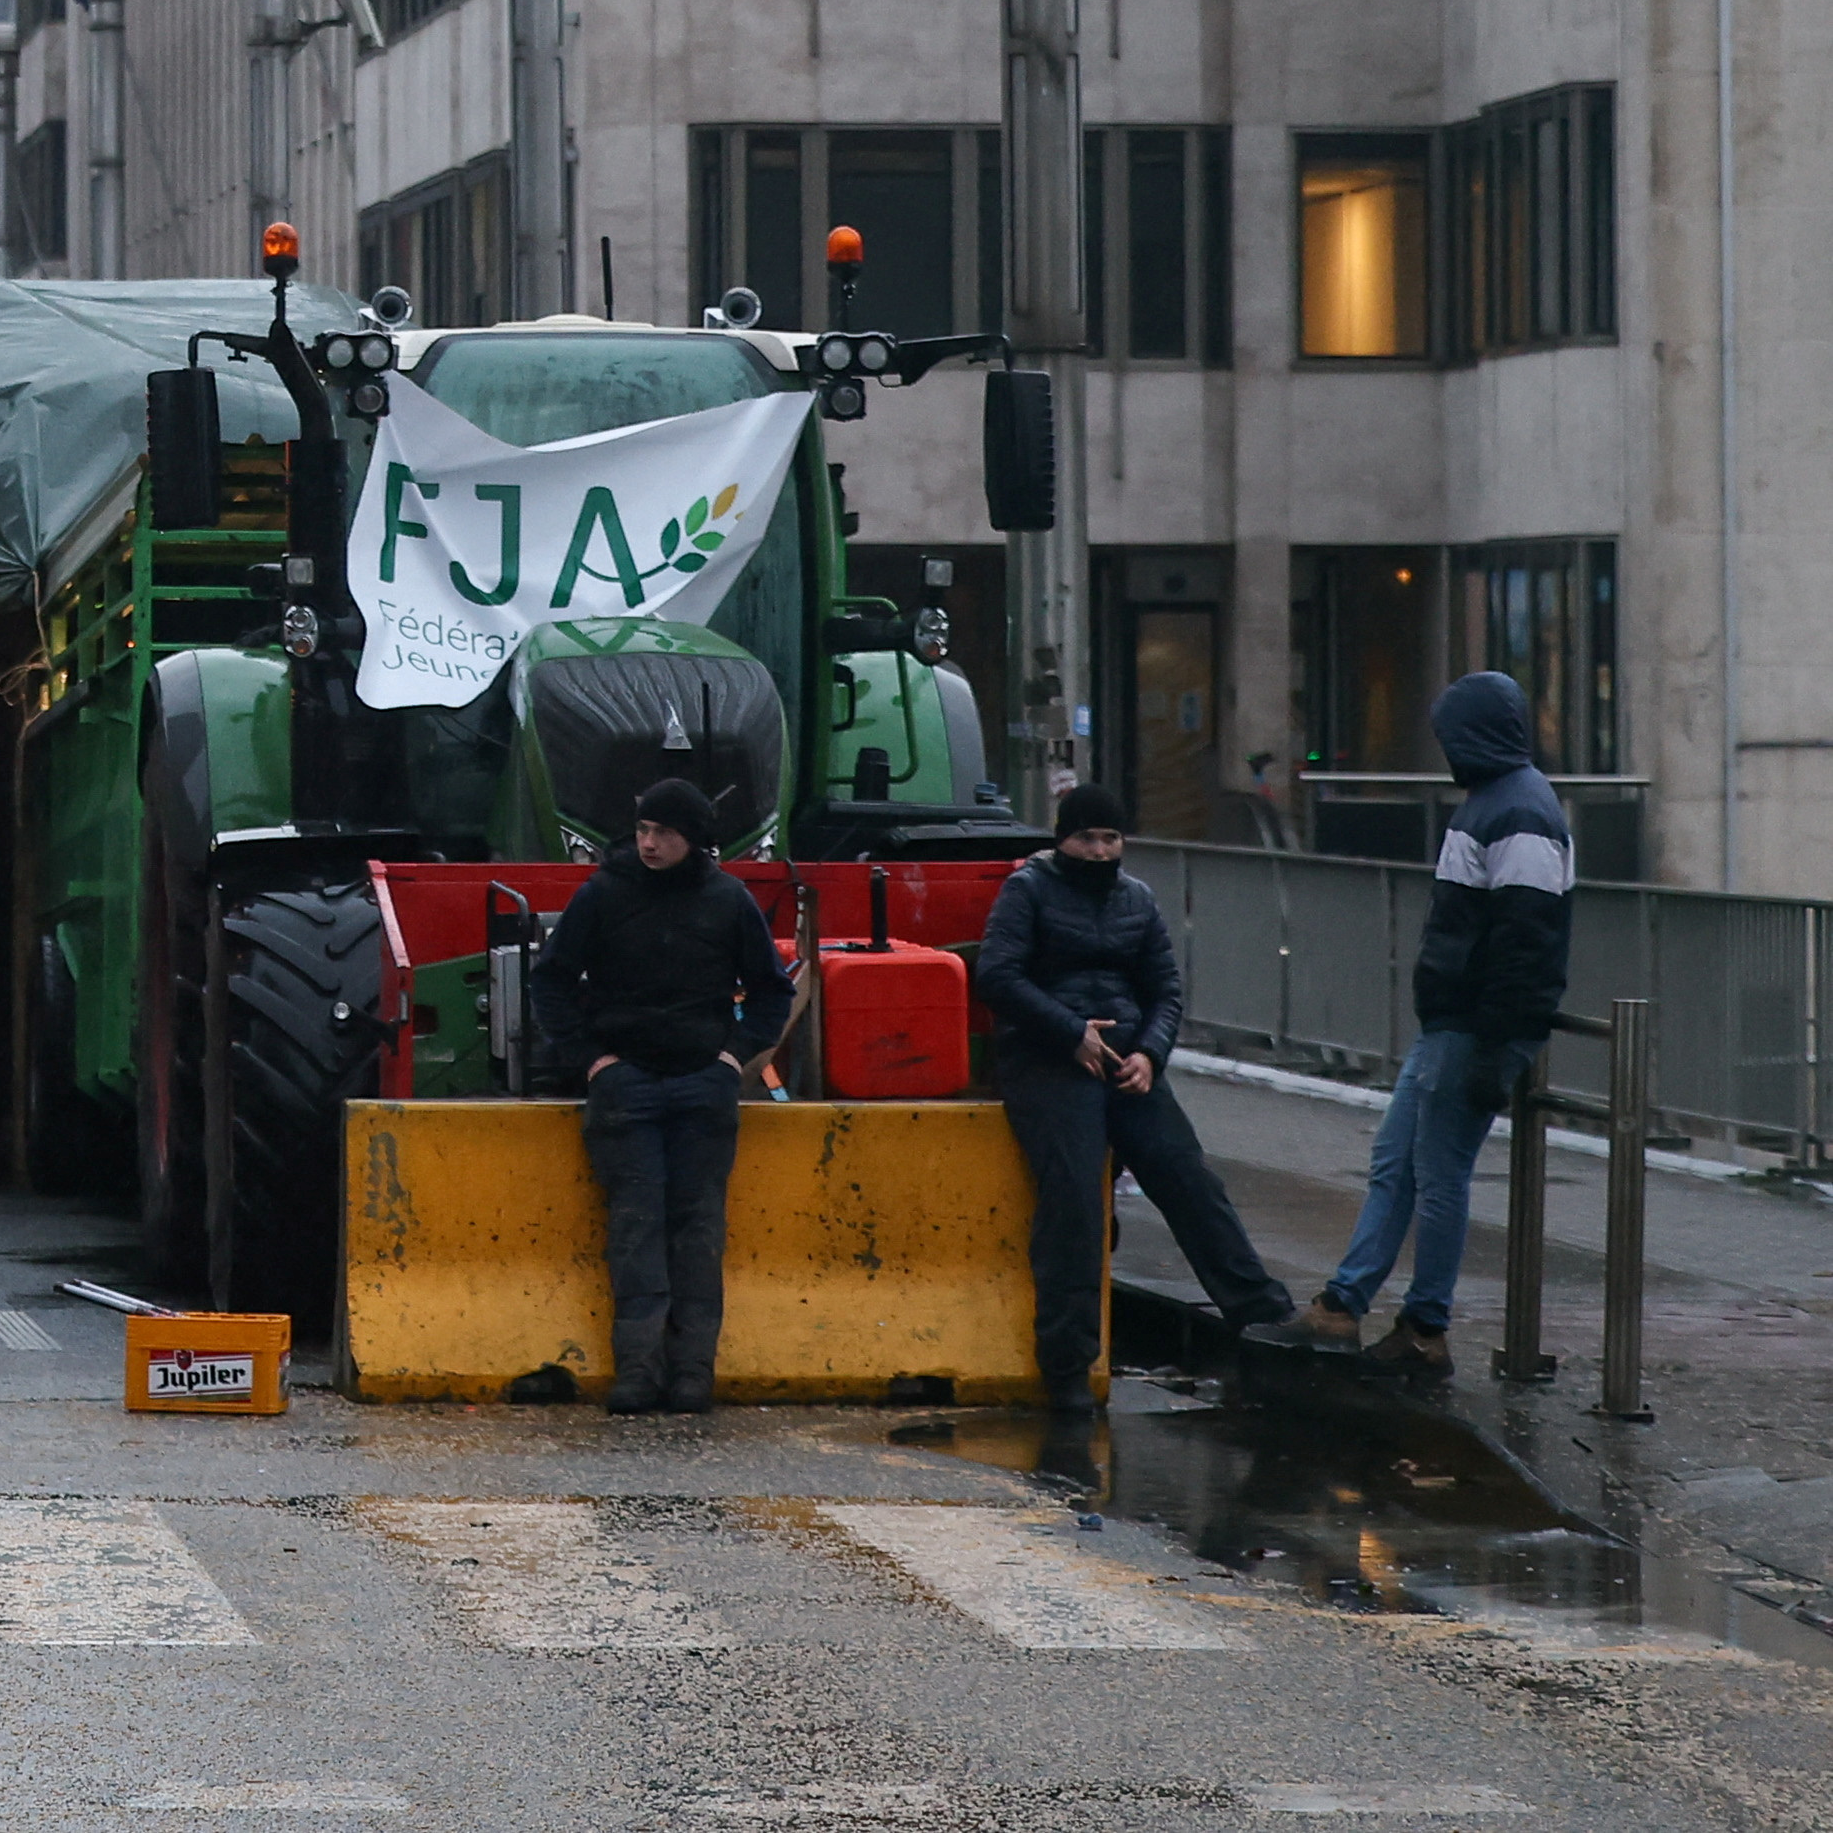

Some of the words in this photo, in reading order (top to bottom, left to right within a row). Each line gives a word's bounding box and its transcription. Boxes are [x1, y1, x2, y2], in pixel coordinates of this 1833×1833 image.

[379, 461, 646, 610] FJA
[378, 598, 519, 661] Fédéra
[157, 1365, 245, 1391] Jupiler
